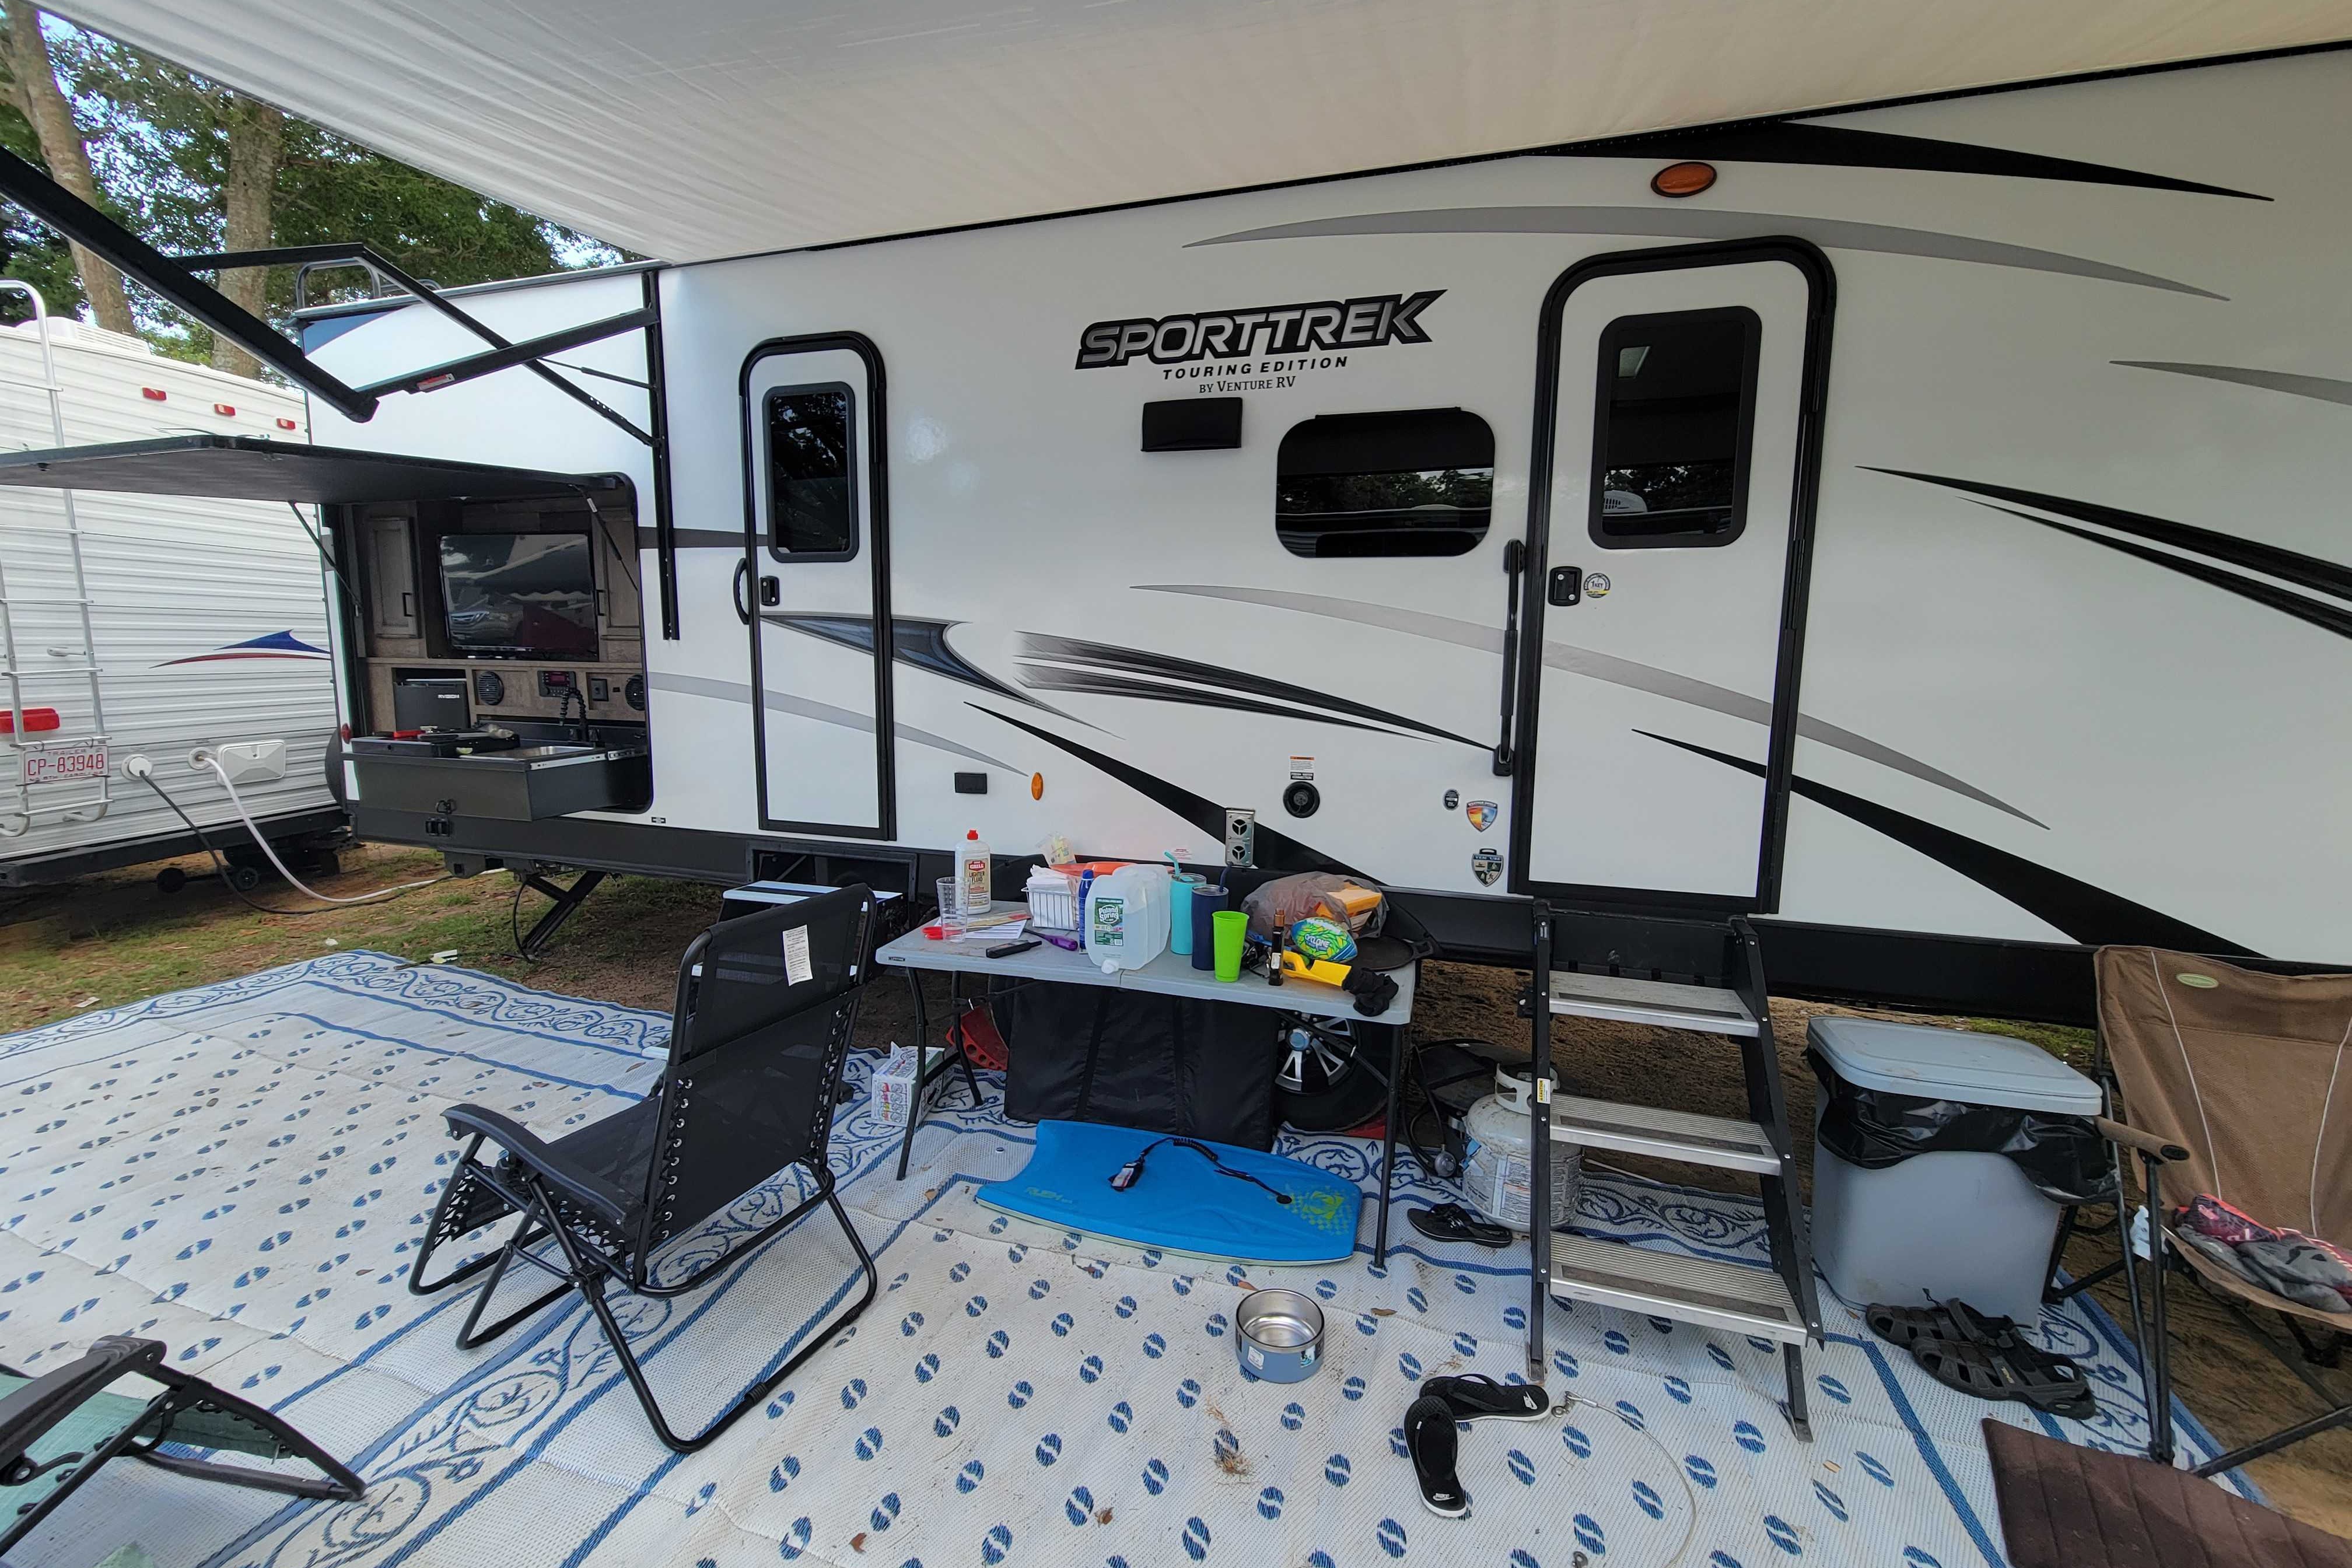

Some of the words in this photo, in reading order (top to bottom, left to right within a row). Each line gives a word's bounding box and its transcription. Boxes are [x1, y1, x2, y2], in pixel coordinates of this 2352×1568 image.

[1076, 292, 1441, 369] SPORTTREK
[1163, 363, 1252, 380] TOURING
[1259, 356, 1348, 373] EDITION
[1276, 376, 1296, 388] RV
[28, 754, 104, 776] CP-83948
[1098, 906, 1118, 915] Poland
[1099, 912, 1119, 922] Spring
